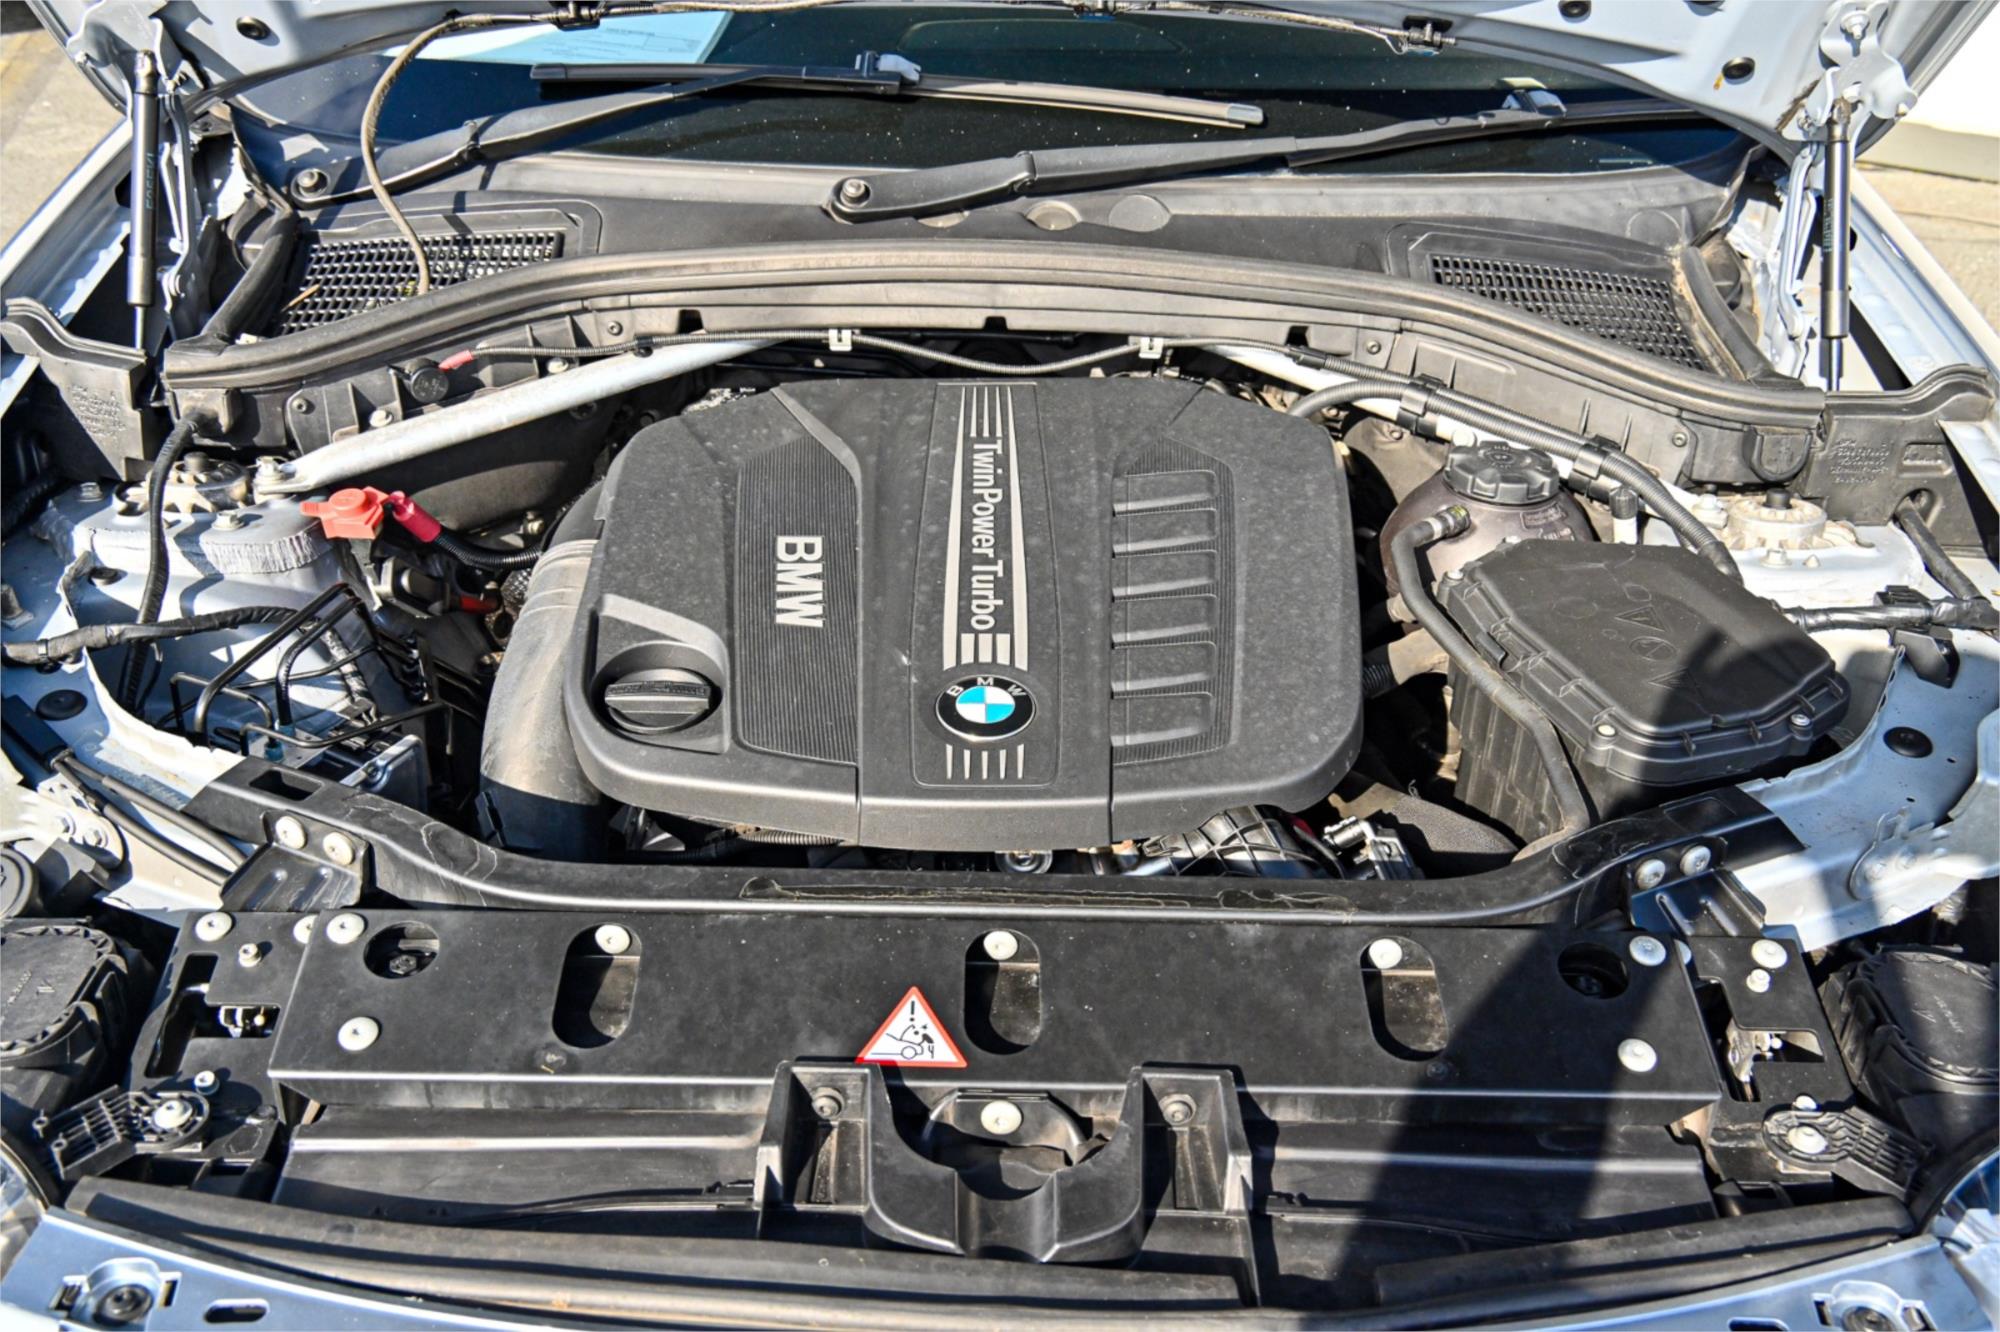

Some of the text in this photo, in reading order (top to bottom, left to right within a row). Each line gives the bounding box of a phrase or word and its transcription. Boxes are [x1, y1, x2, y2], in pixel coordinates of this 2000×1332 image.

[970, 439, 1004, 630] TwinPower Turbo
[776, 536, 823, 628] BMW
[946, 676, 1028, 697] BMW
